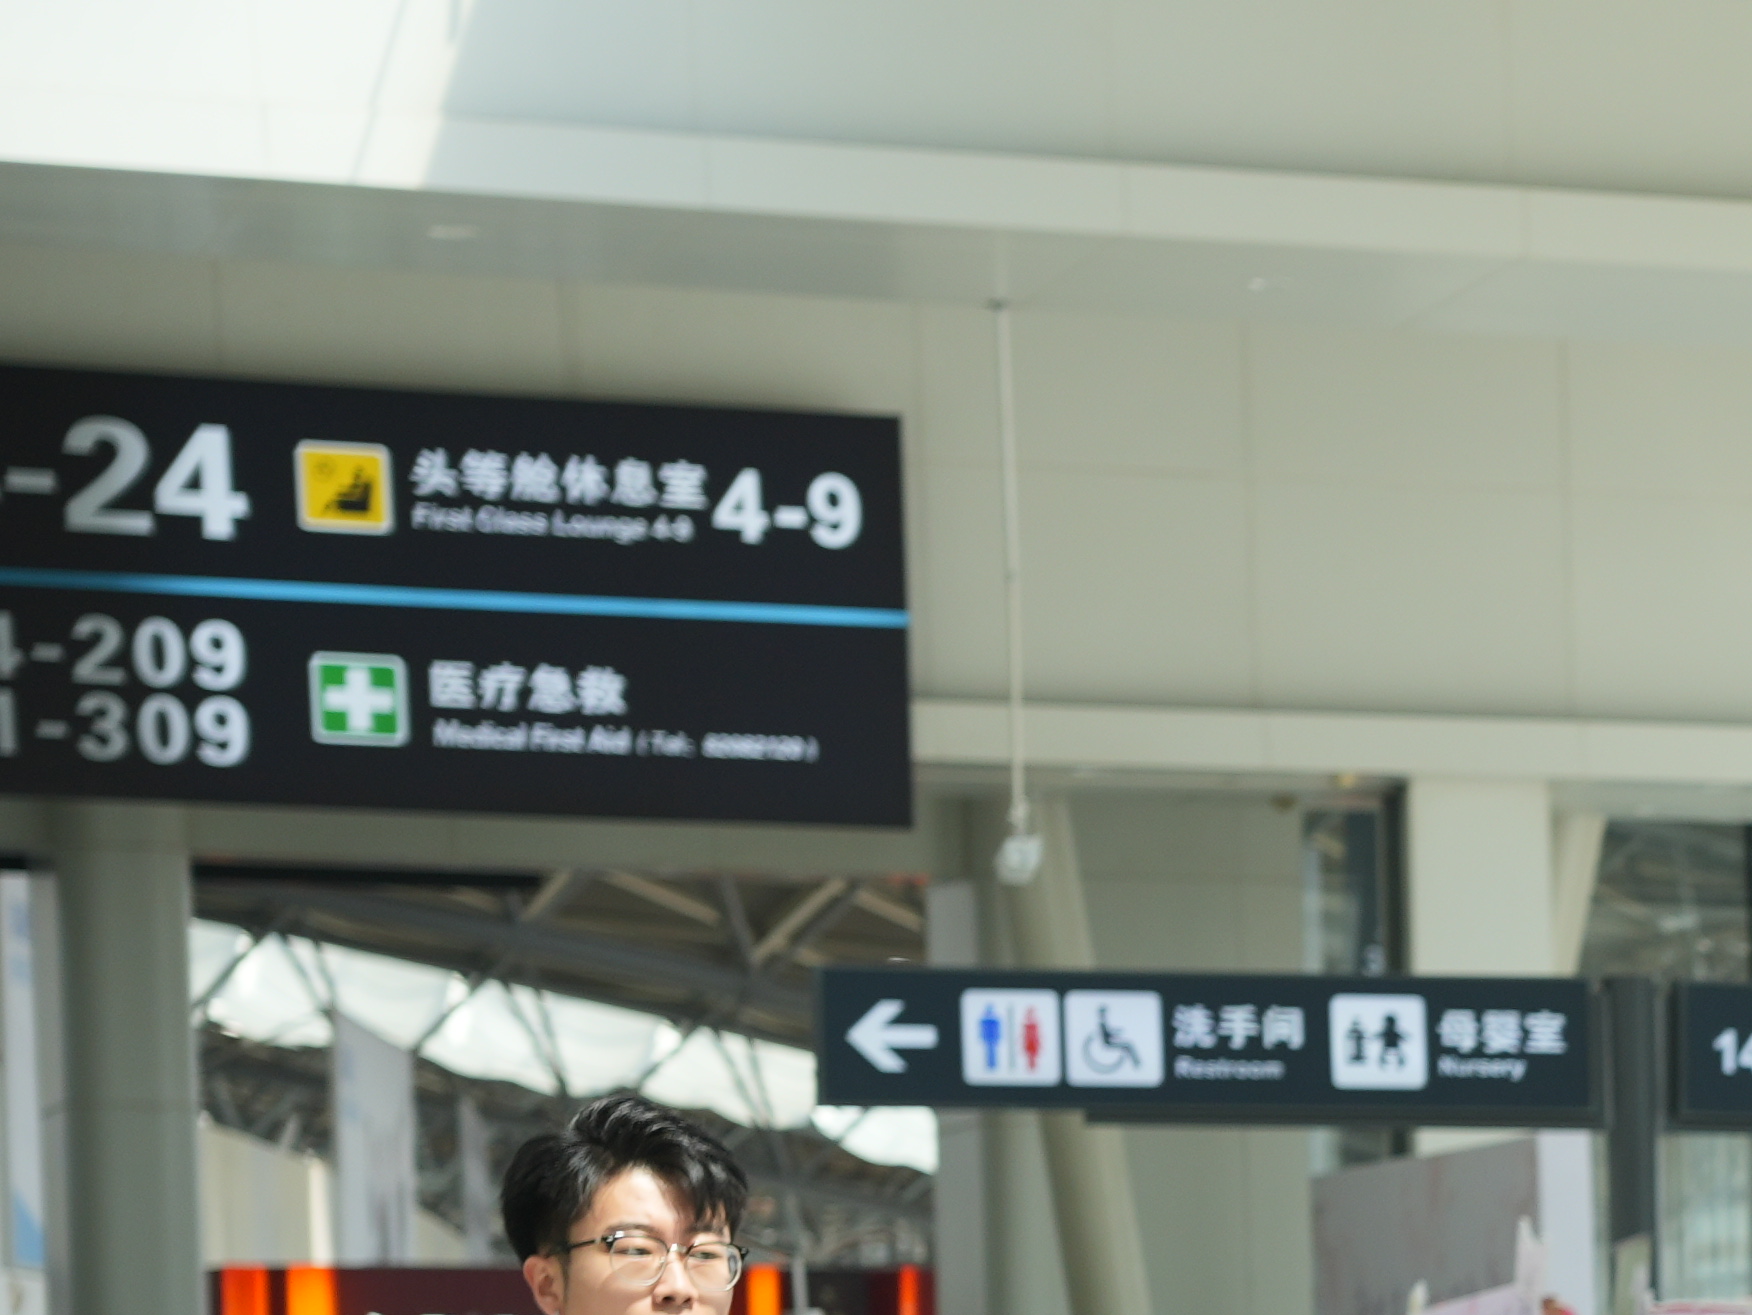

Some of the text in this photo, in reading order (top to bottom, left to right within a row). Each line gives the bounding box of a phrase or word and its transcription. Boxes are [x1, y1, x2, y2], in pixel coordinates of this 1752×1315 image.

[410, 448, 863, 549] 头等舱休息室 4-9
[411, 502, 474, 531] First
[475, 504, 548, 537] Class
[551, 509, 648, 546] Lounge
[428, 659, 628, 716] 医疗急救
[432, 717, 528, 752] Medical
[528, 722, 586, 754] First
[587, 724, 632, 756] Aid
[1173, 1004, 1568, 1055] 洗手间 母婴室
[1174, 1056, 1529, 1083] Restroom Nursery
